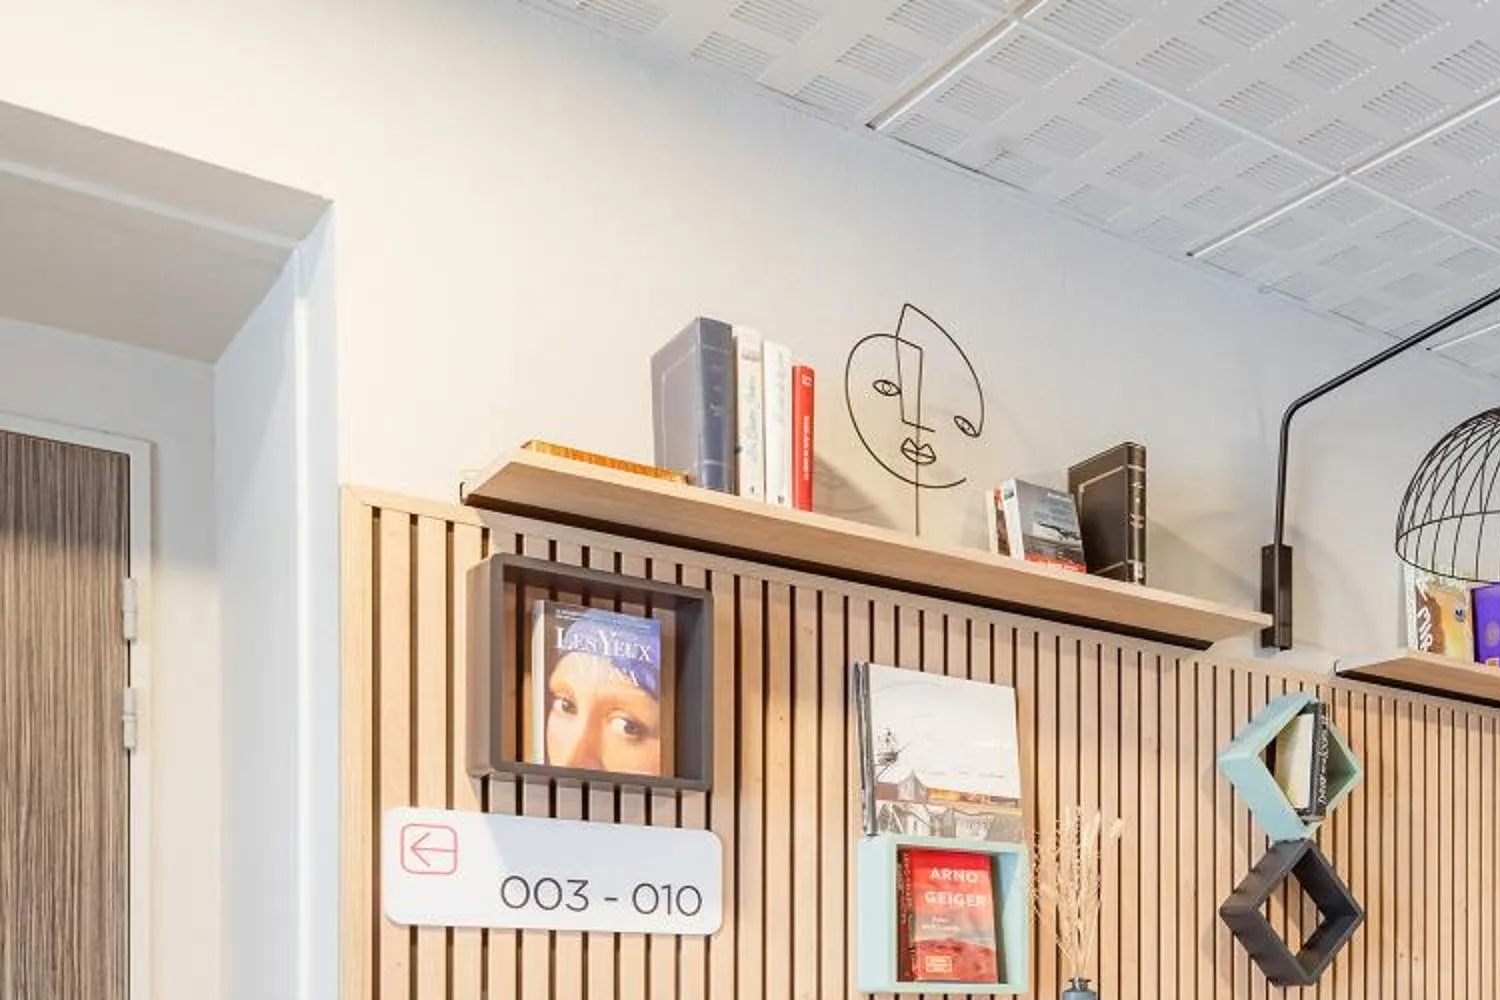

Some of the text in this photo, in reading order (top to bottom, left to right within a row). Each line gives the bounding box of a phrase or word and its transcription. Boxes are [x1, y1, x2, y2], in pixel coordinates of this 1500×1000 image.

[929, 867, 978, 884] ARNO
[501, 875, 590, 912] 003
[631, 882, 702, 916] 010
[924, 891, 986, 907] GEIGER
